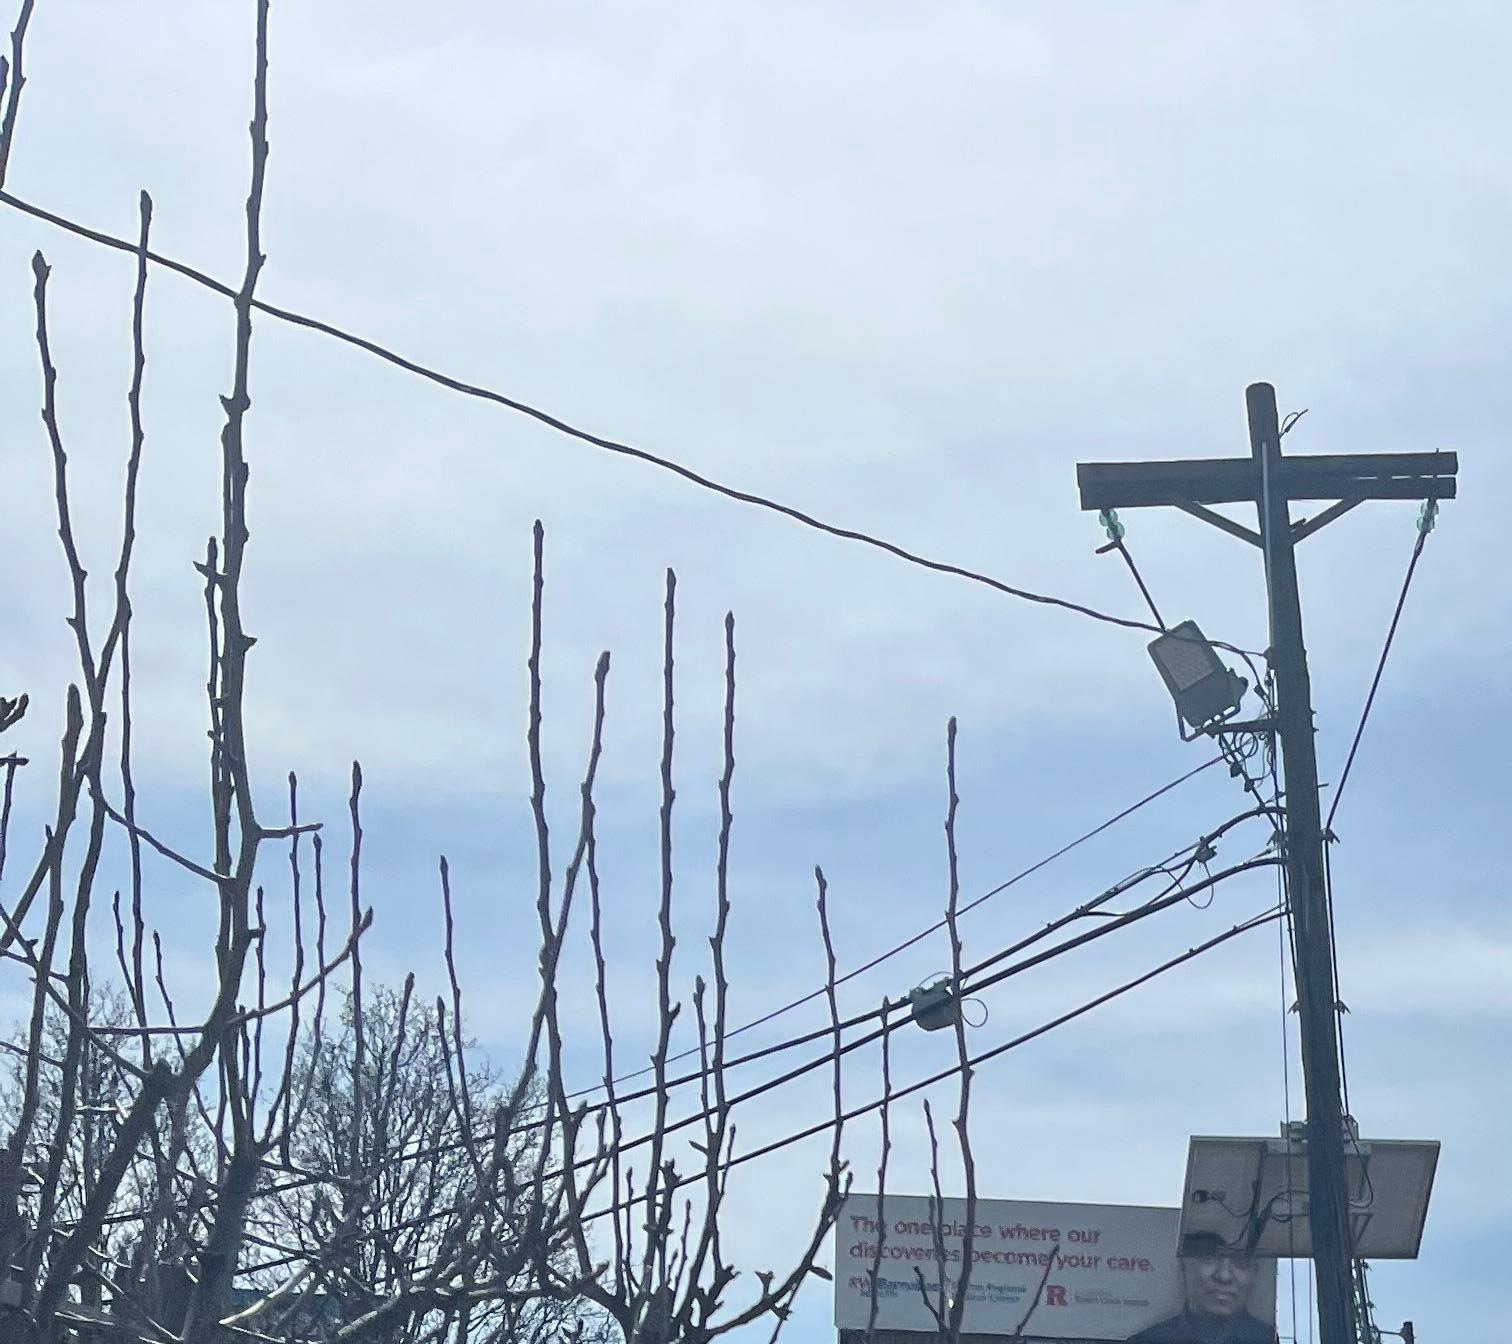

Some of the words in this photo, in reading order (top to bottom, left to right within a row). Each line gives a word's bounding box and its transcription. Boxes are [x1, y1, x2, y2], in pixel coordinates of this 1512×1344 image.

[894, 1220, 932, 1235] one
[999, 1222, 1061, 1242] where
[1067, 1227, 1101, 1243] our
[849, 1240, 961, 1262] discoveres
[1056, 1252, 1100, 1271] your
[1106, 1255, 1156, 1272] care.
[1046, 1284, 1069, 1307] R
